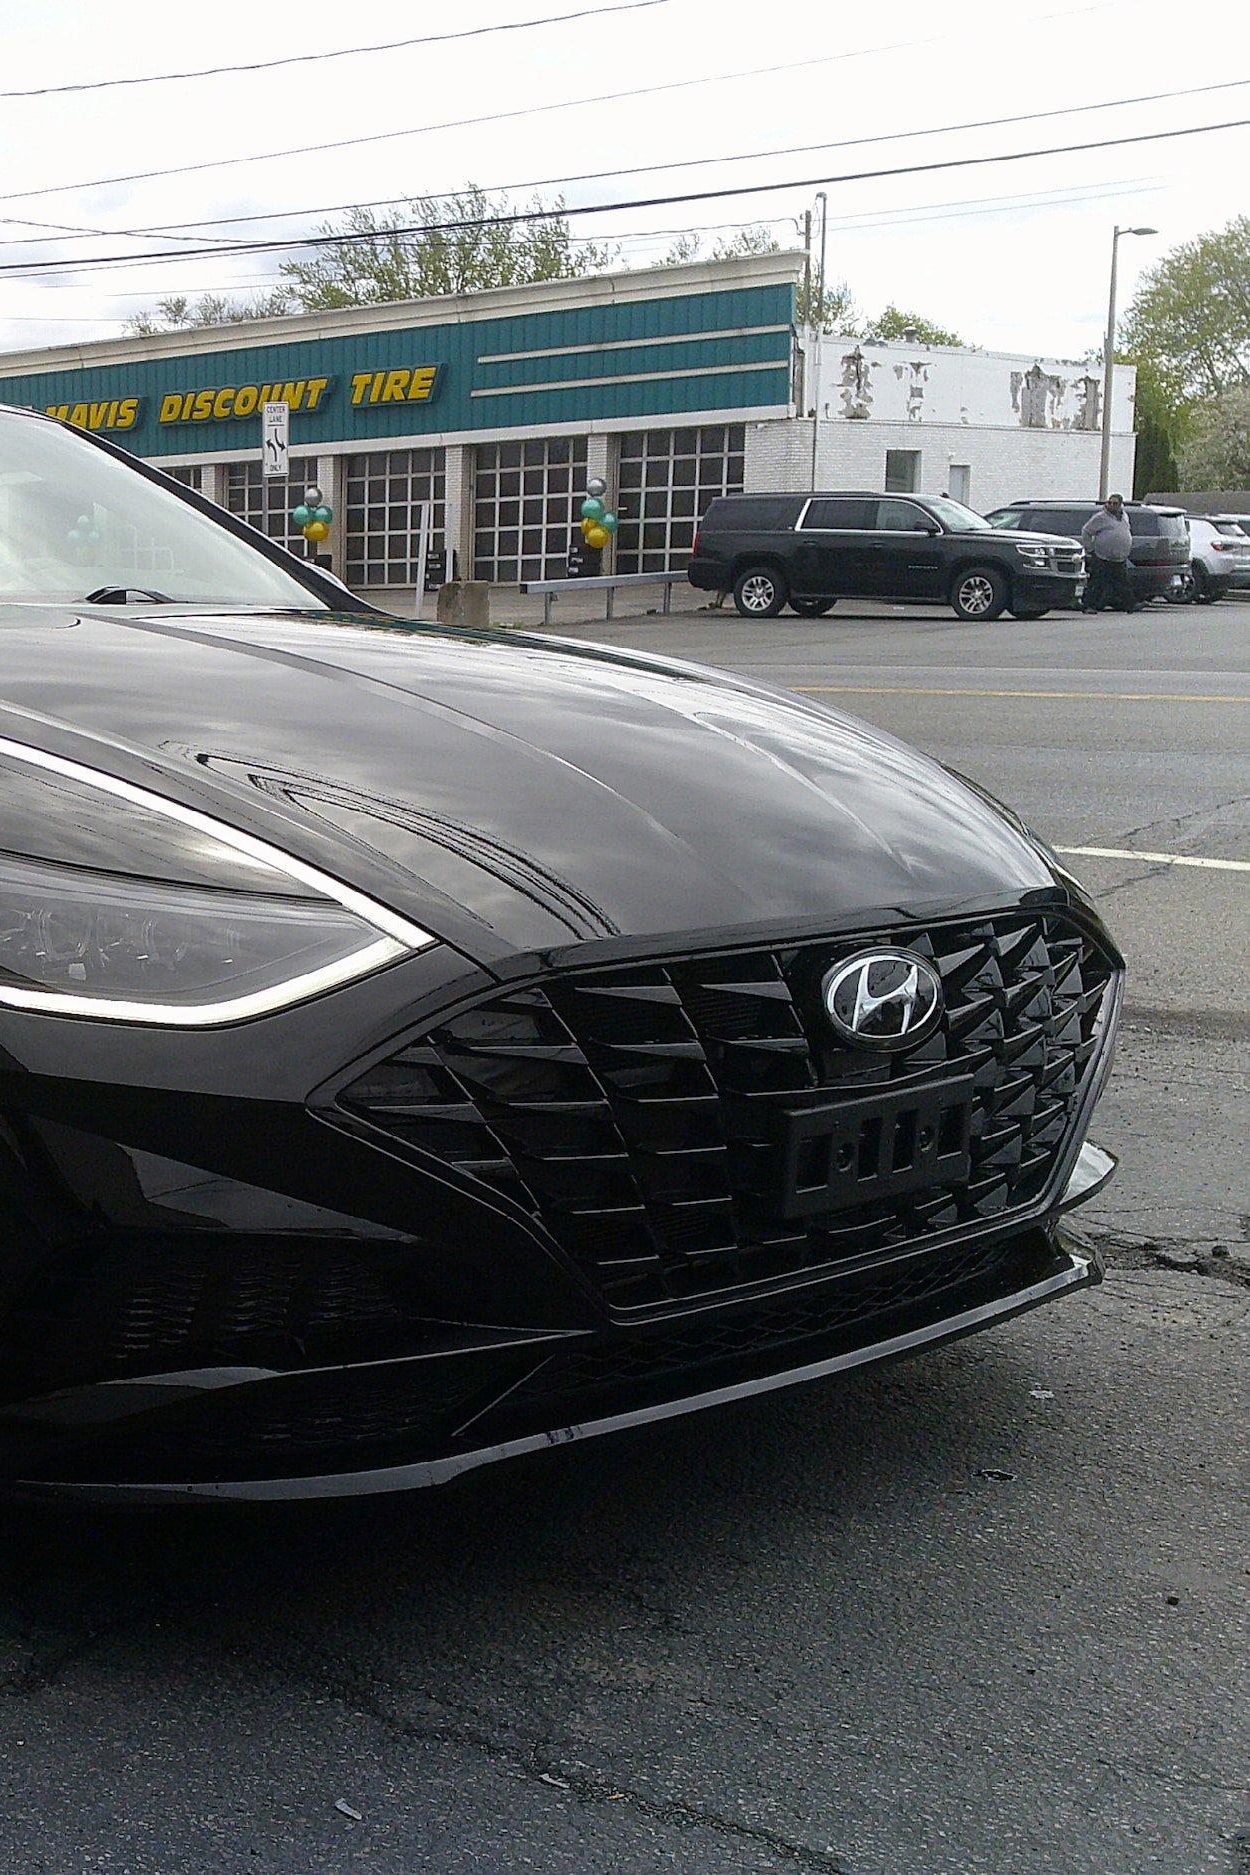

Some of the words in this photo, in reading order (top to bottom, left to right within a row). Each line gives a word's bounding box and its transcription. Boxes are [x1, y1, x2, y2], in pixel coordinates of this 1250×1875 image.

[159, 379, 327, 422] DISCOUNT
[351, 367, 436, 404] TIRE
[267, 406, 285, 414] CENTER
[269, 415, 282, 423] LANE
[270, 464, 282, 472] ONLY
